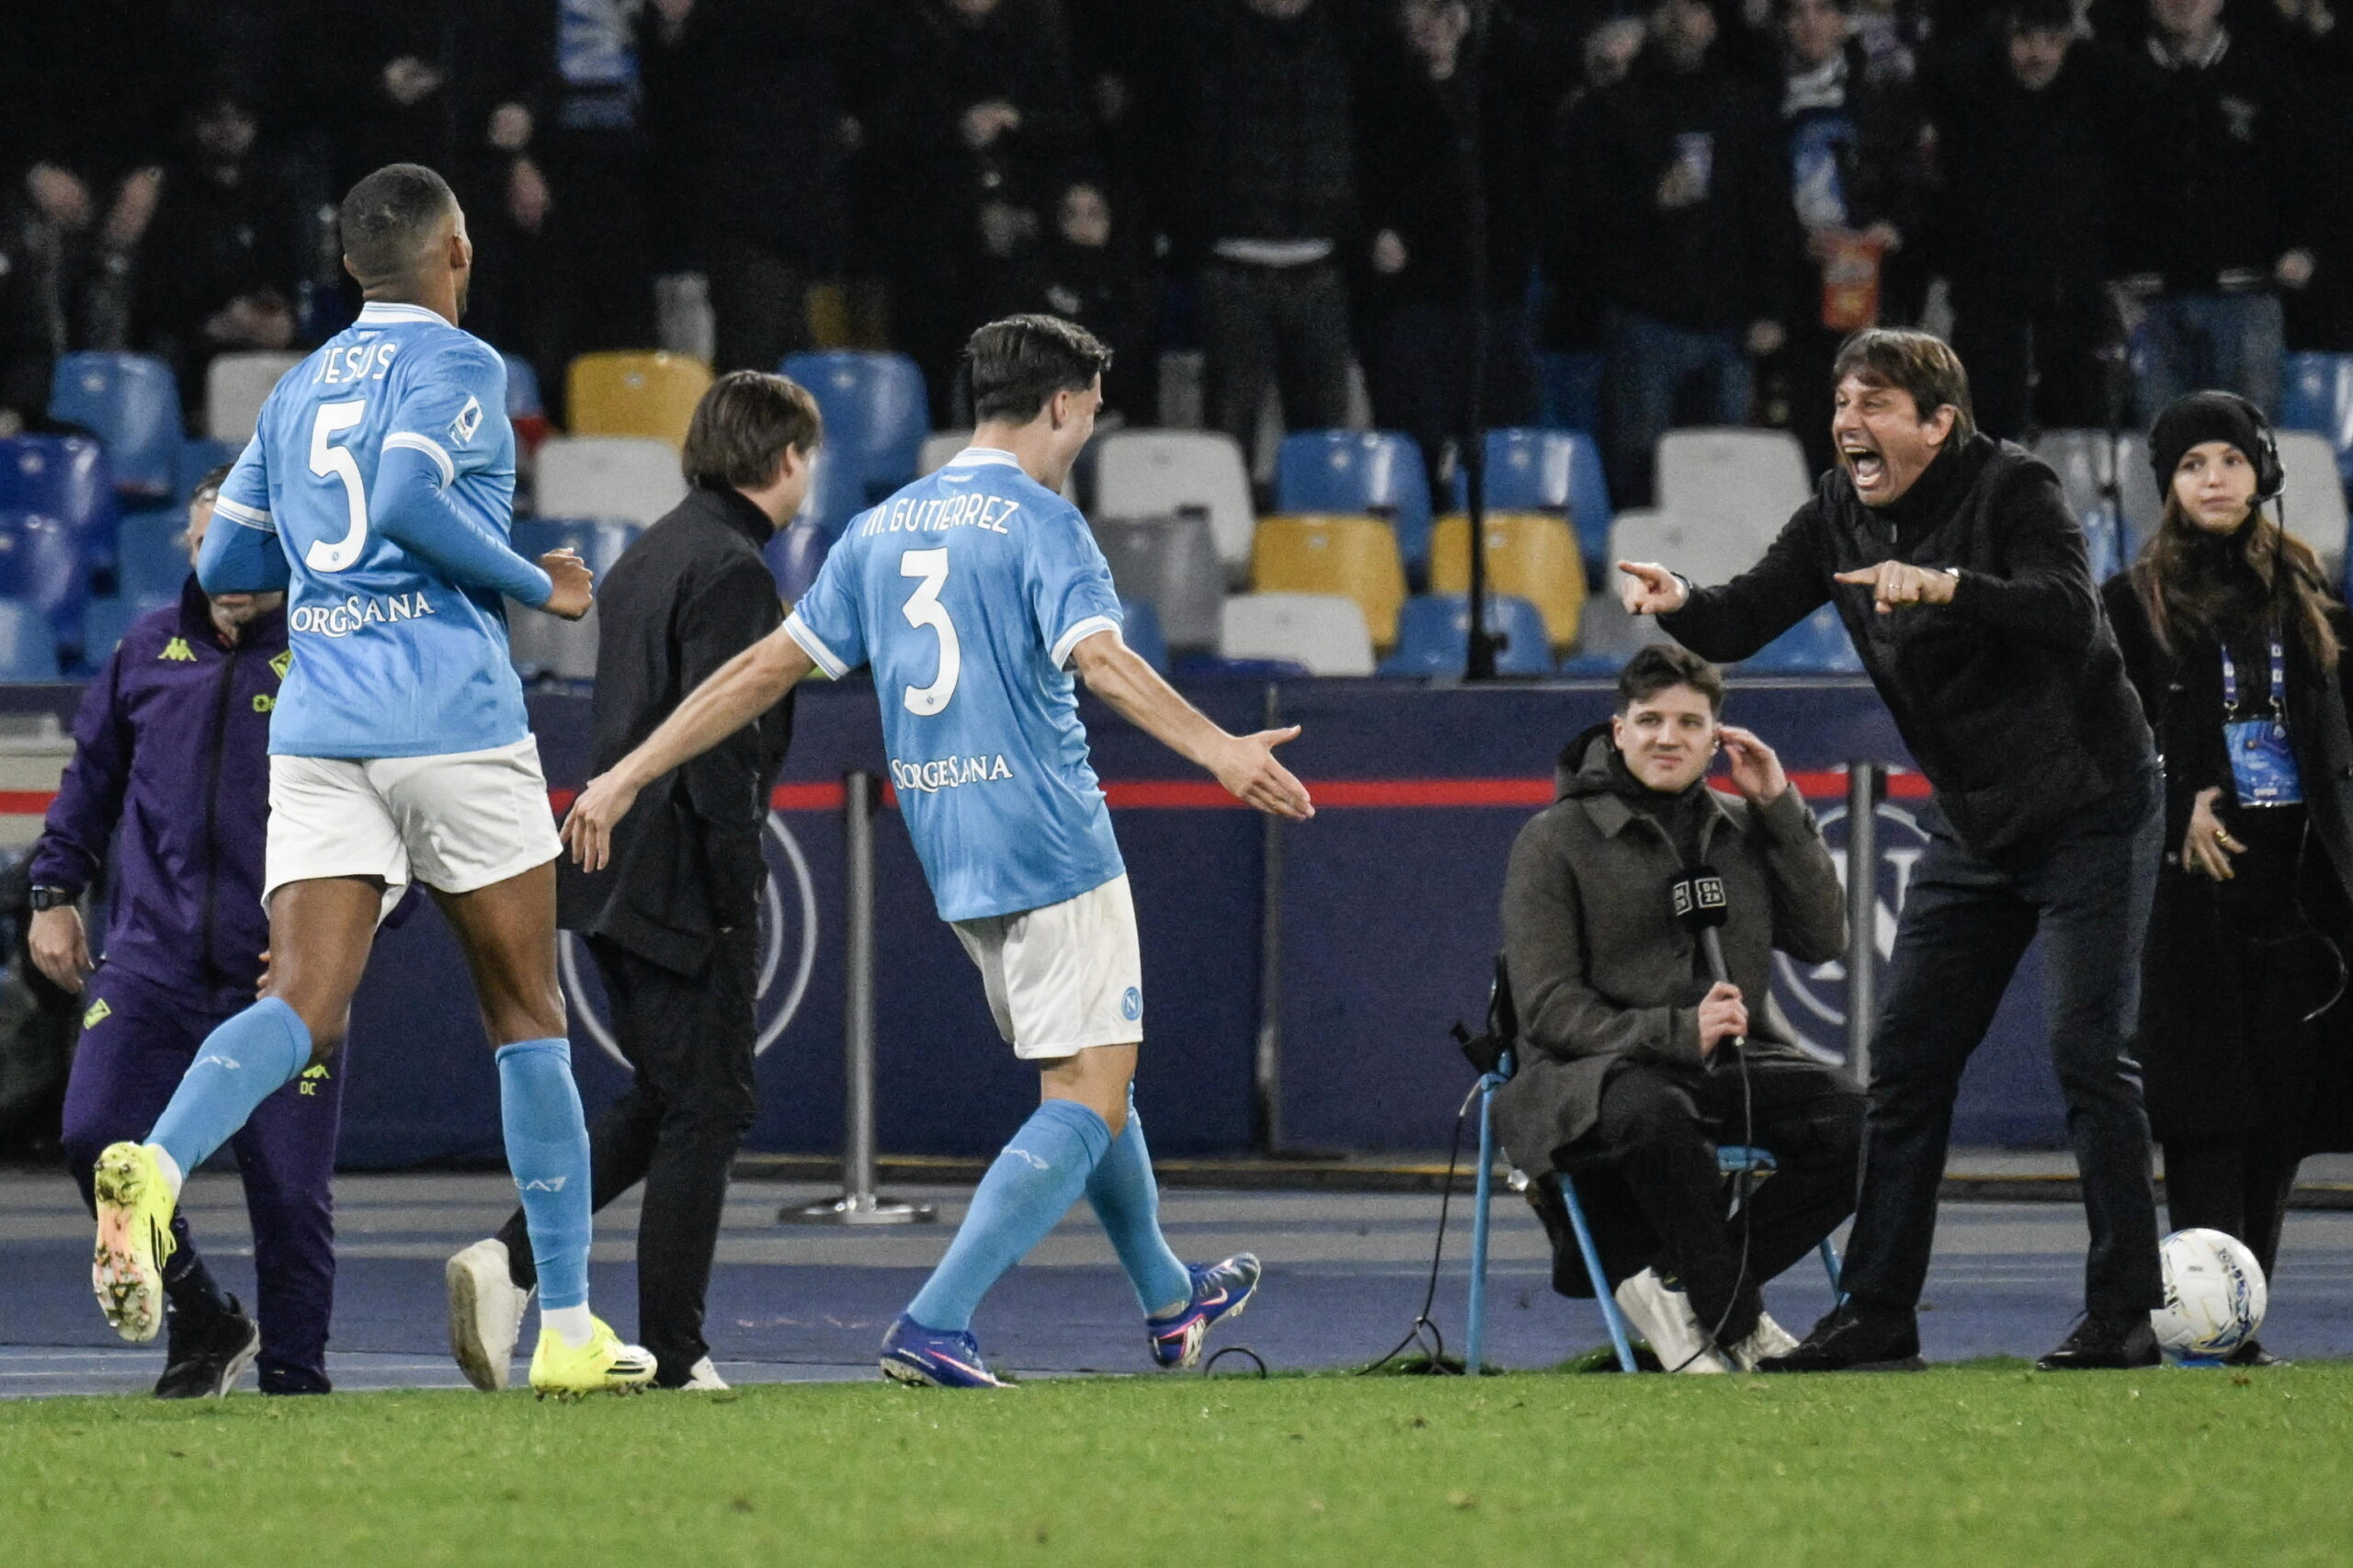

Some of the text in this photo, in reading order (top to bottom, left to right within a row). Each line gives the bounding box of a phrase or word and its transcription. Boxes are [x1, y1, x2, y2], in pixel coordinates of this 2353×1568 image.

[312, 343, 397, 384] JESUS
[305, 399, 368, 573] 5
[290, 591, 436, 638] ORGSANA
[900, 547, 961, 716] 3
[891, 755, 1014, 793] SORGESANA
[300, 1081, 317, 1096] DC
